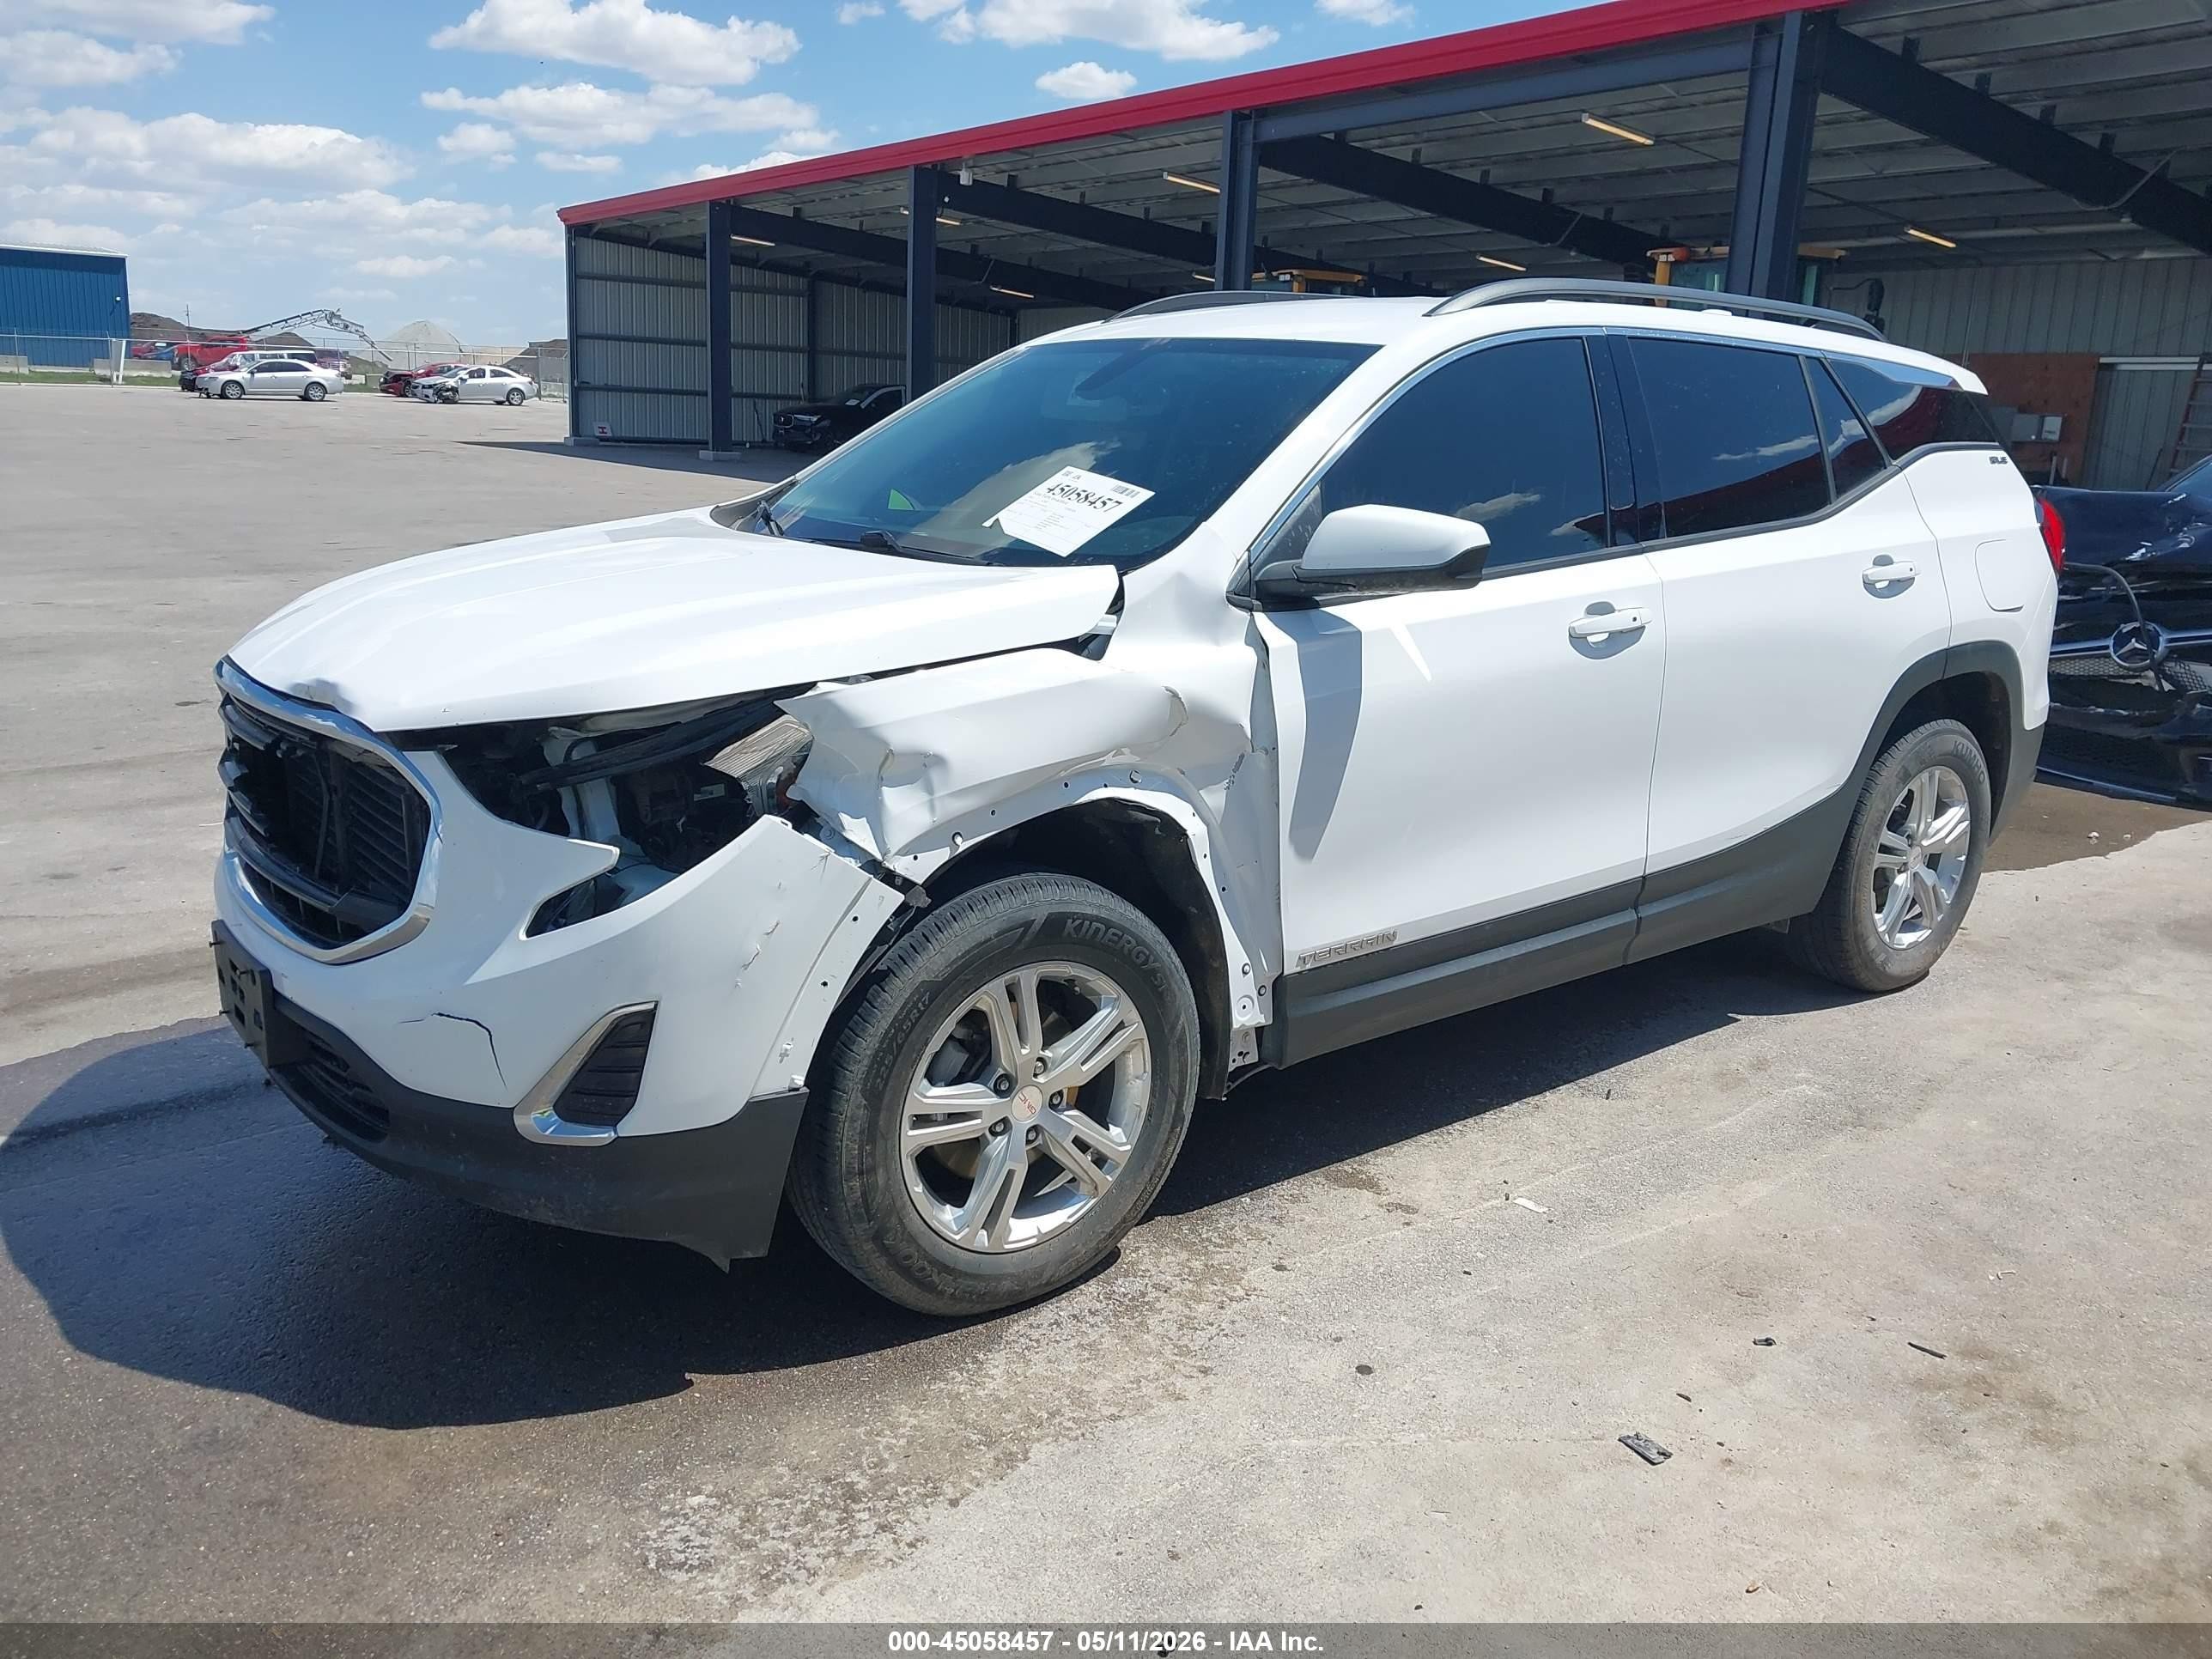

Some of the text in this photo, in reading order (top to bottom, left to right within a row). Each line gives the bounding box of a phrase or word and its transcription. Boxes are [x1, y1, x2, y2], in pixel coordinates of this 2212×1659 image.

[1046, 482, 1123, 513] 45058457
[1952, 740, 1985, 784] KUMHO
[1062, 918, 1162, 969] KINERGY
[1297, 928, 1399, 967] TERRAIN
[1018, 1091, 1036, 1114] GMC
